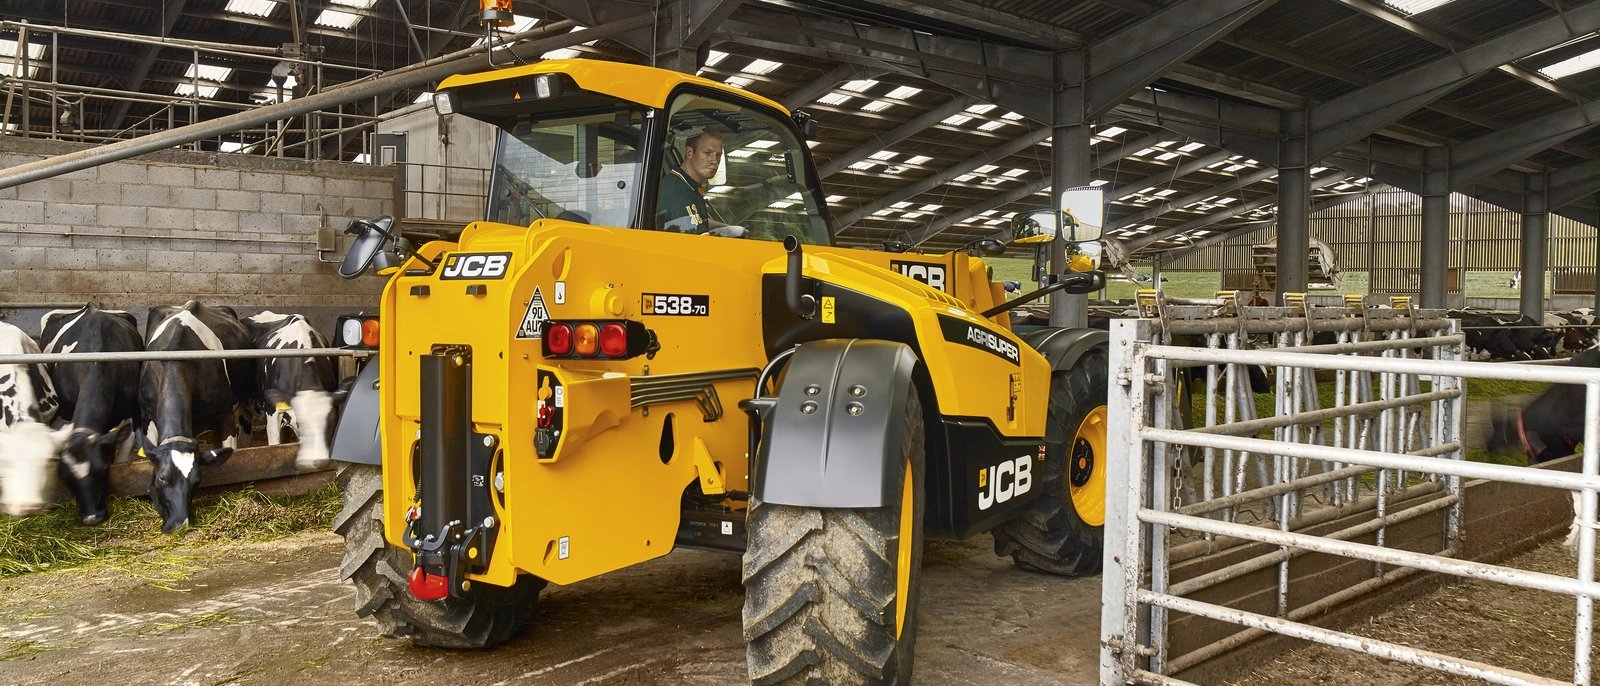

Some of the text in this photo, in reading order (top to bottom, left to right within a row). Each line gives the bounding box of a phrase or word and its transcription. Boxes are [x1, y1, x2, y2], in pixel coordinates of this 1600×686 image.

[444, 255, 508, 277] JCB
[531, 306, 543, 320] 90
[967, 326, 1019, 362] AGRISUPER
[978, 454, 1032, 511] JCB
